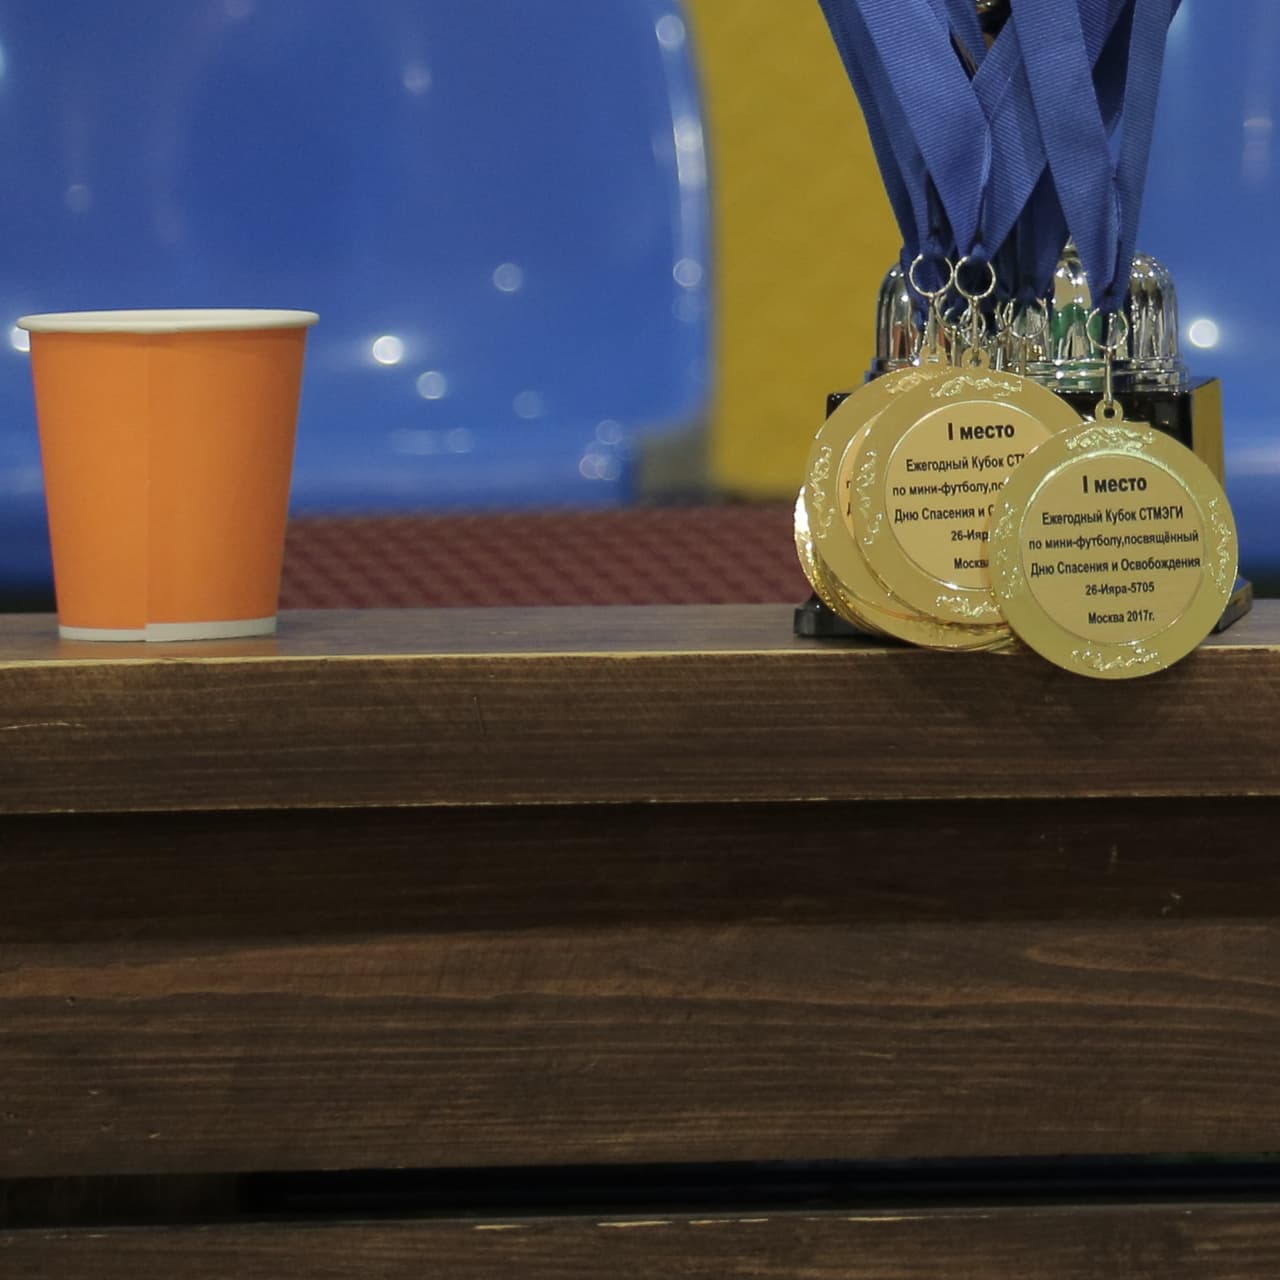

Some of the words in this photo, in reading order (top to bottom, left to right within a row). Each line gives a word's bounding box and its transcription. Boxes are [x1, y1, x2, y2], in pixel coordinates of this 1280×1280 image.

[960, 424, 1015, 440] место
[906, 456, 969, 472] Ежегодный
[972, 454, 1004, 471] Кубок
[893, 485, 906, 496] по
[1095, 476, 1147, 492] место
[895, 508, 919, 523] Дню
[922, 507, 975, 521] Спасения
[978, 508, 985, 517] и
[1042, 510, 1102, 527] Ежегодный
[1105, 508, 1136, 525] Кубок
[1139, 505, 1183, 520] СТМЭГИ
[951, 530, 988, 542] 26-Ияр
[1029, 539, 1042, 550] по
[1031, 563, 1054, 578] Дню
[1057, 560, 1109, 574] Спасения
[1112, 562, 1118, 571] и
[1121, 557, 1200, 572] Освобождения
[1086, 581, 1155, 597] 26-Ияра-5705
[1088, 612, 1124, 624] Москва
[1127, 609, 1155, 623] 2017г.
